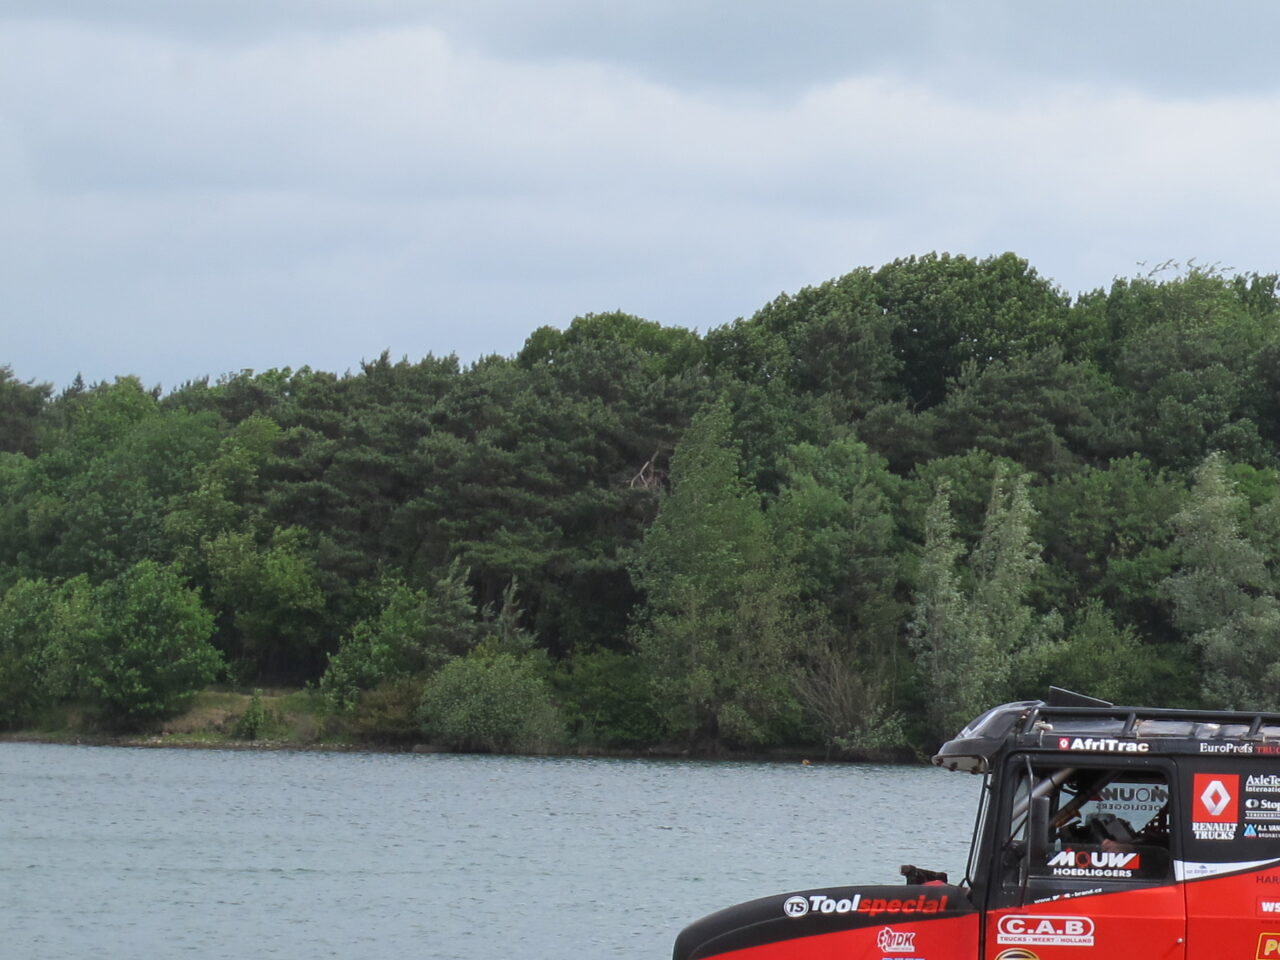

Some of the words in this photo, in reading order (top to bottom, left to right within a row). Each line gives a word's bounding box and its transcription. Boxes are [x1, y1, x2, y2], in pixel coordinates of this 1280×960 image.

[1071, 738, 1149, 751] AfriTrac
[1192, 822, 1238, 831] RENAULT
[1194, 831, 1235, 840] TRUCKS
[1047, 850, 1138, 868] MOUW
[1053, 868, 1132, 878] HOEDLIGGERS
[788, 901, 806, 913] TS
[1006, 919, 1084, 934] C.A.B
